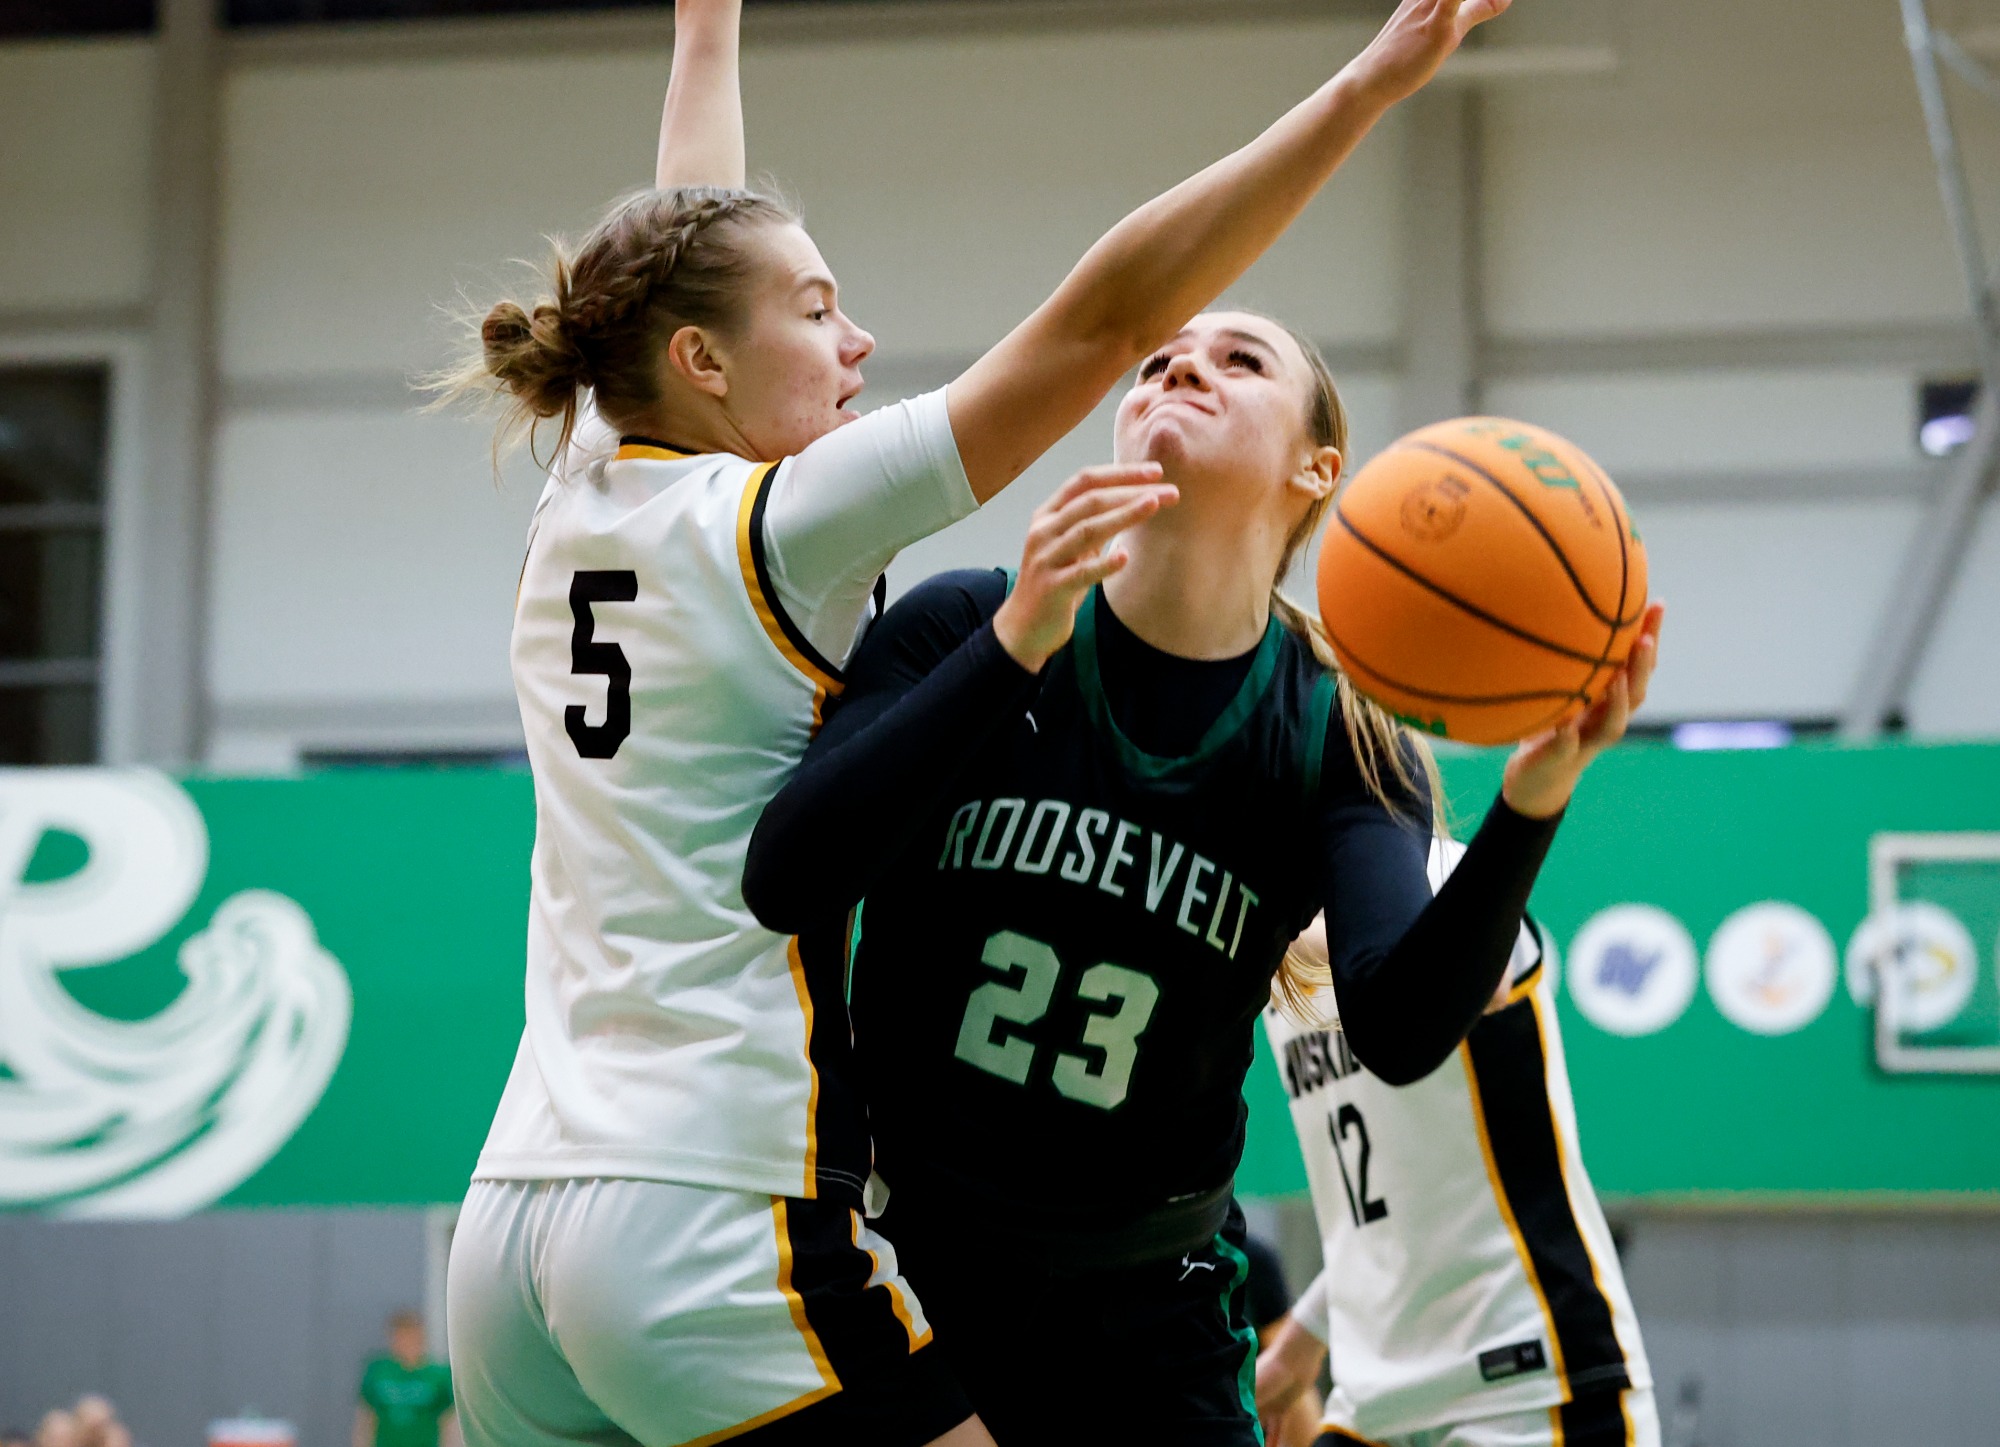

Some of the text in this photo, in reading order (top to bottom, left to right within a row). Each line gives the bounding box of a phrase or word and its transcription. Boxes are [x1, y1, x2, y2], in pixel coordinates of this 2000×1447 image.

[564, 569, 639, 760] 5
[938, 798, 1259, 961] ROOSEVELT
[954, 929, 1159, 1110] 23
[1327, 1103, 1389, 1228] 12
